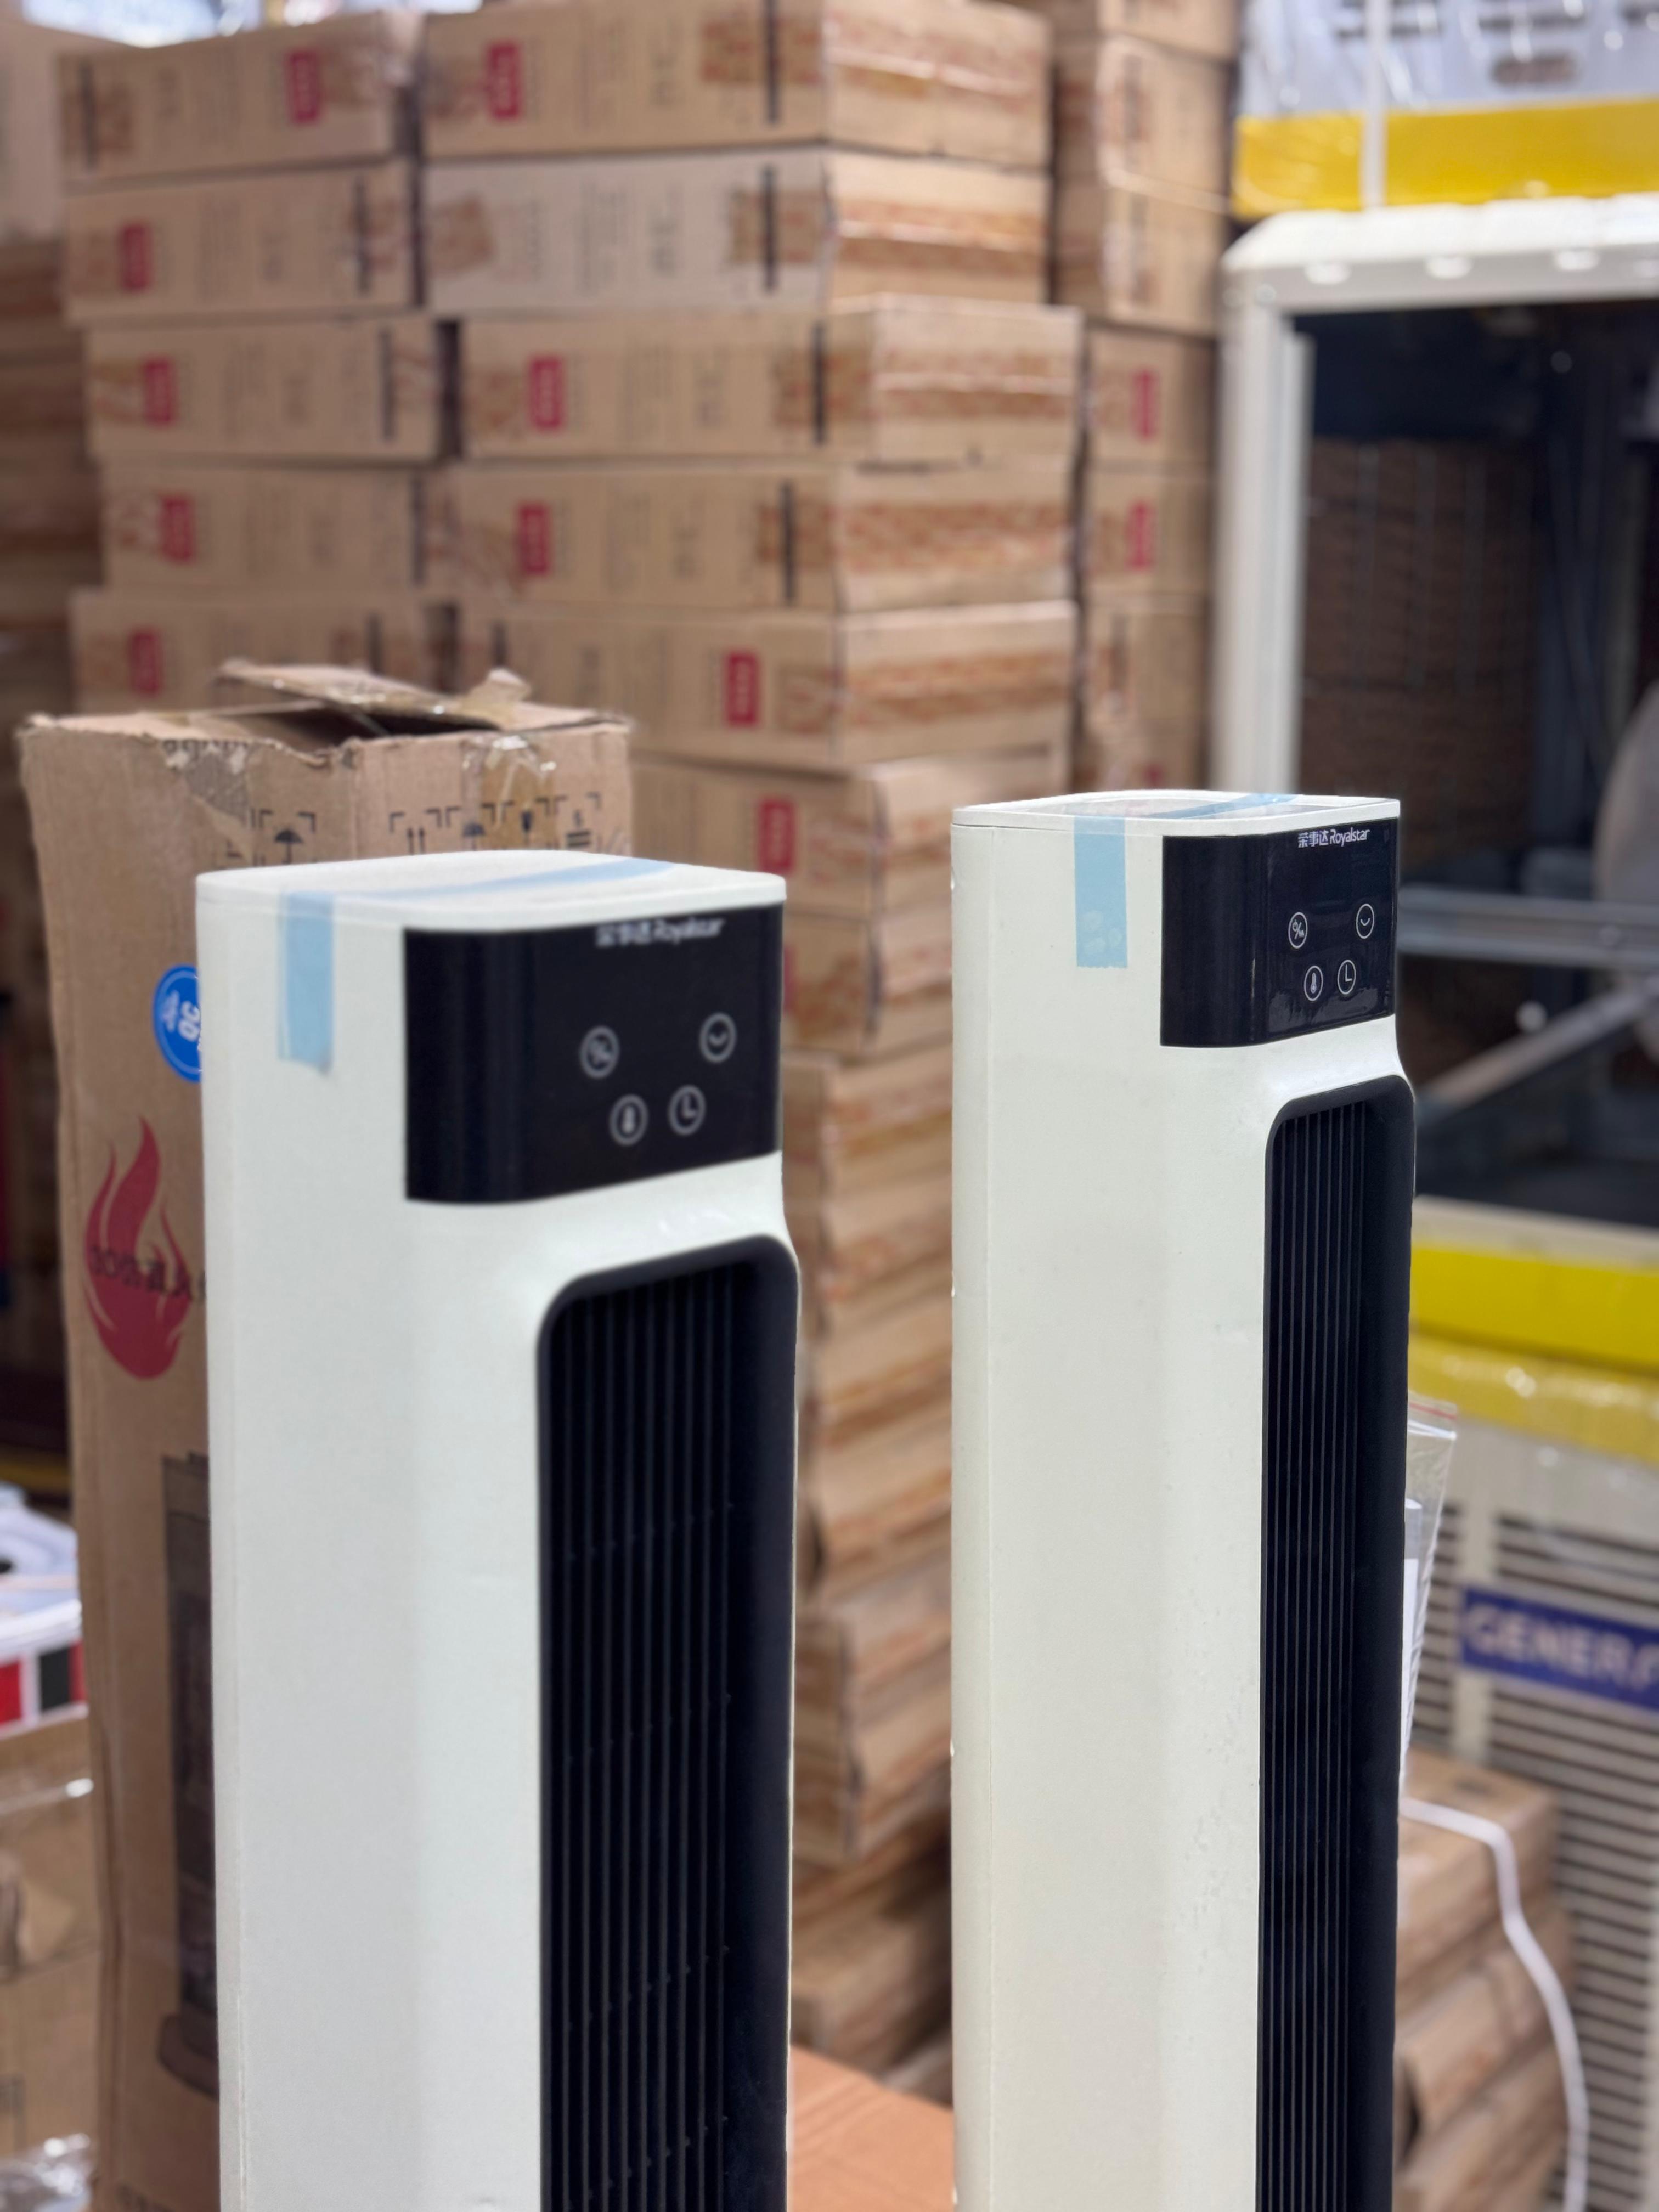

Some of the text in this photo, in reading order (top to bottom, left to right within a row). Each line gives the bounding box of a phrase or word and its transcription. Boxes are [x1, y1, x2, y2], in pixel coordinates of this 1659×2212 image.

[1298, 827, 1370, 848] 荣事达 Royalstar
